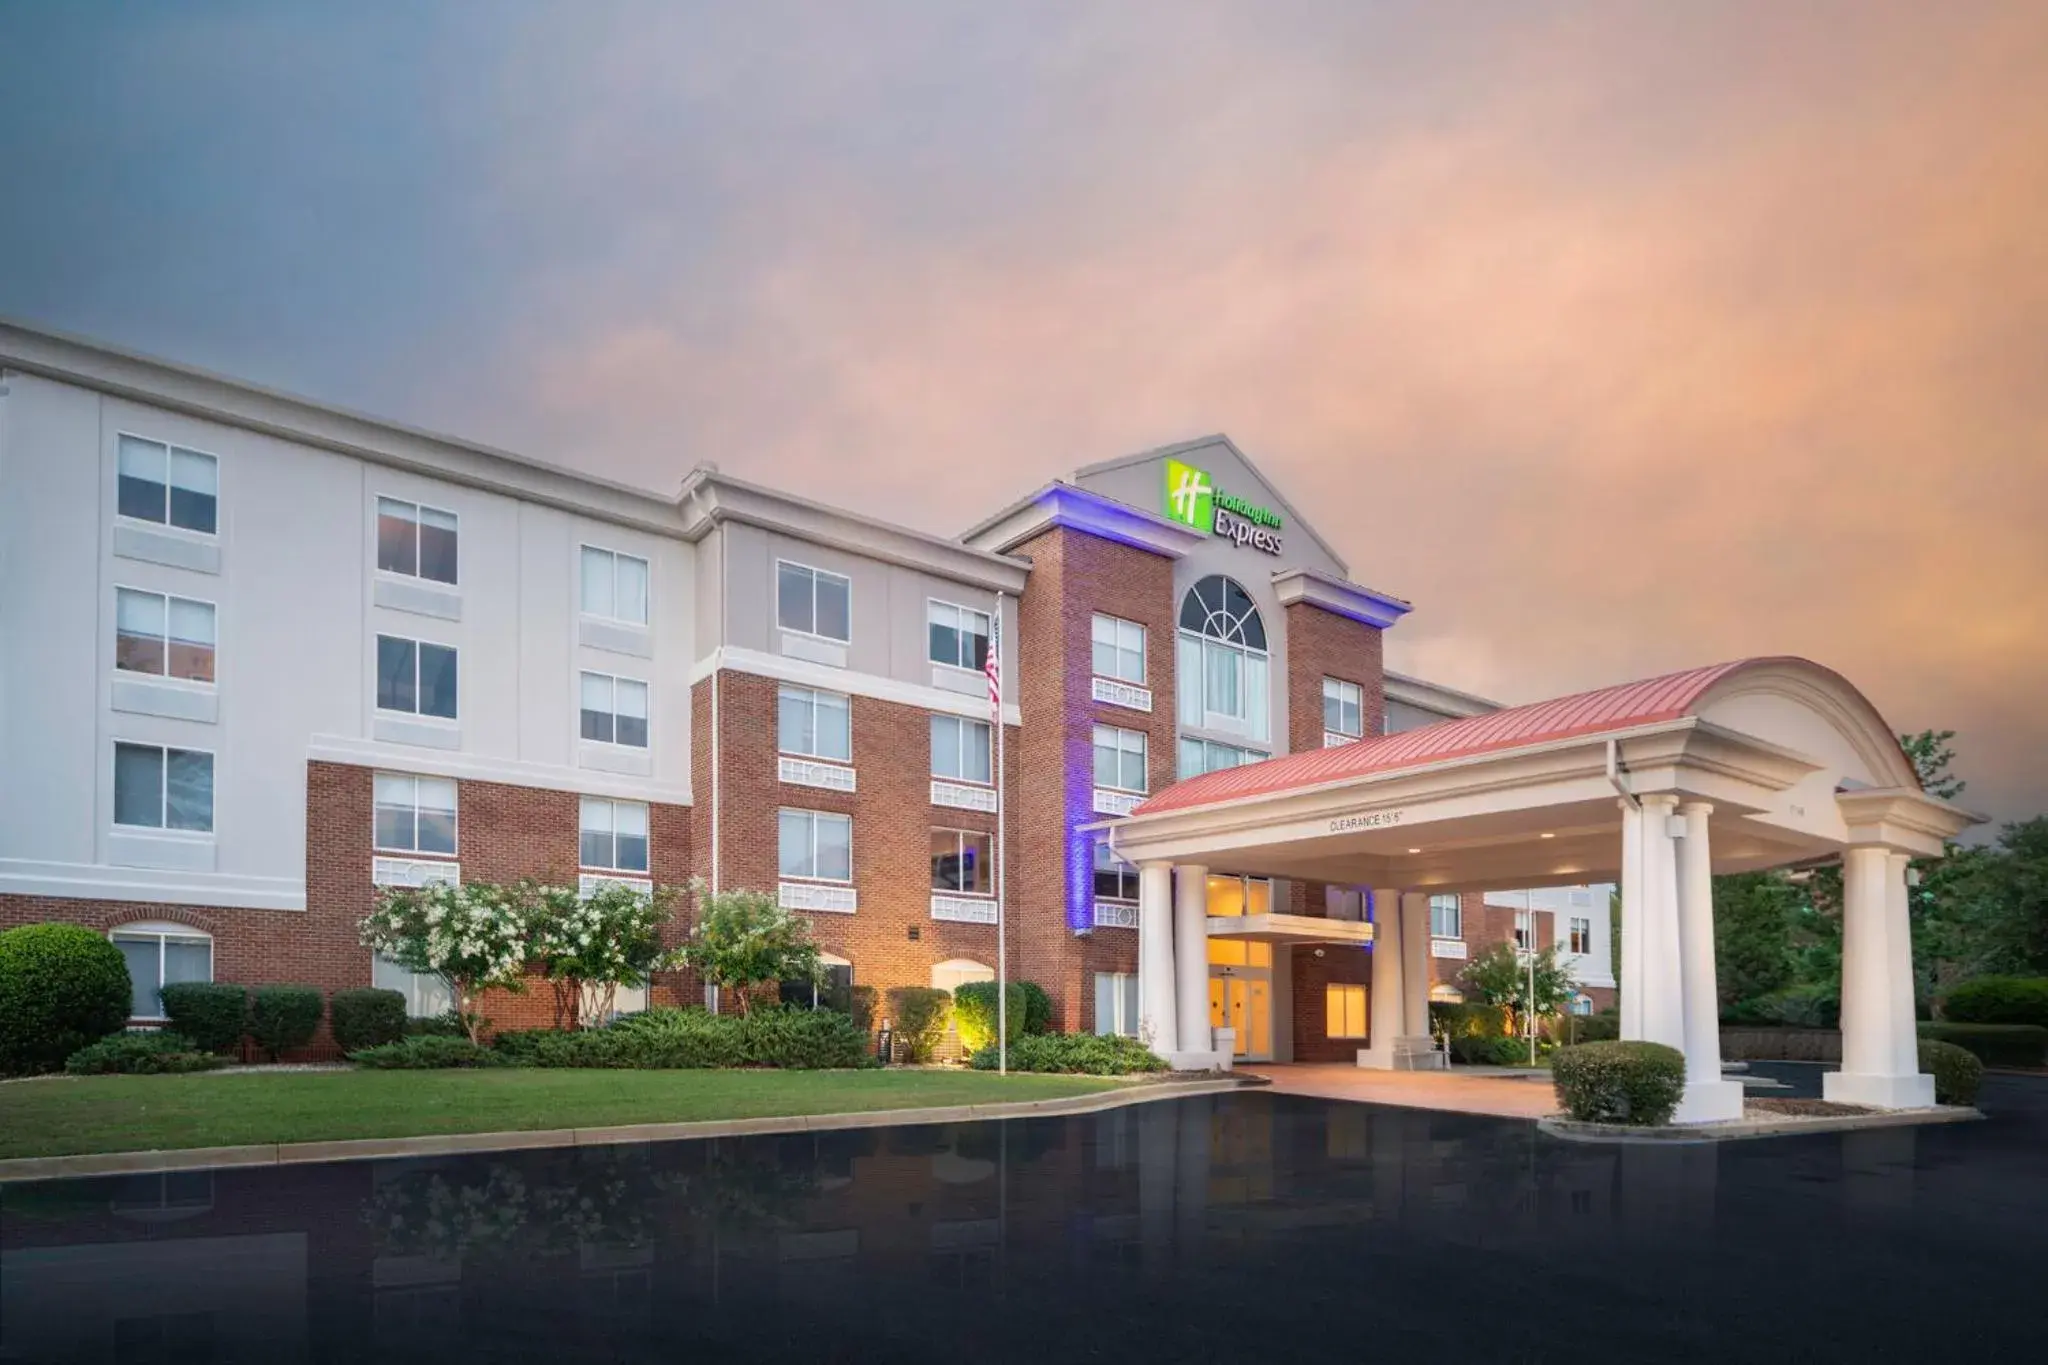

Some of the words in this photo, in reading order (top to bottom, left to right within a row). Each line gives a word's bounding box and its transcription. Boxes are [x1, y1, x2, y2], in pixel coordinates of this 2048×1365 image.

[1213, 487, 1262, 525] Holiday
[1262, 507, 1281, 530] Inn
[1214, 508, 1283, 555] Express
[1330, 814, 1380, 832] CLEARANCE
